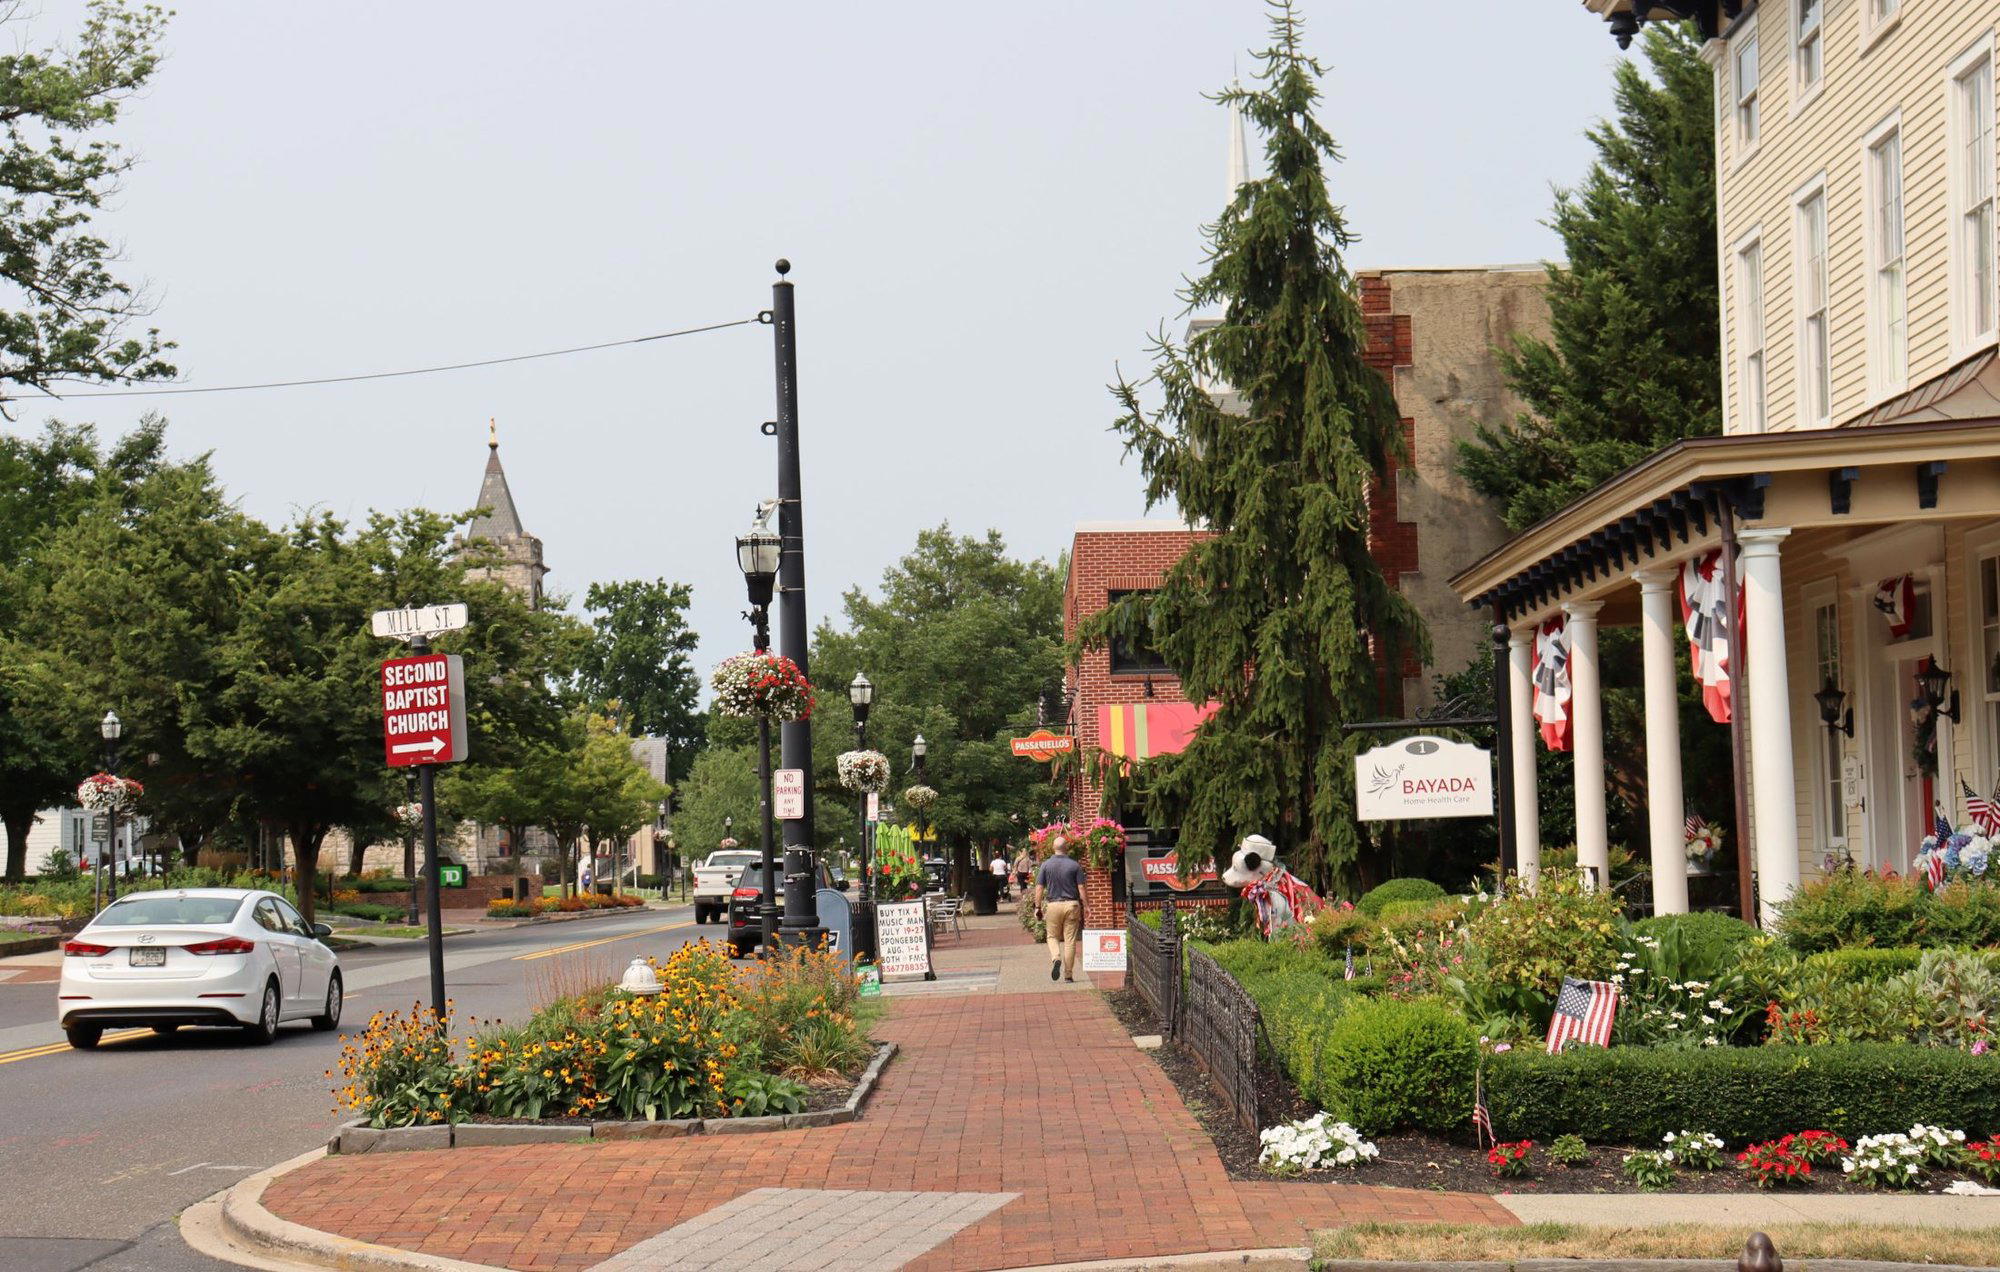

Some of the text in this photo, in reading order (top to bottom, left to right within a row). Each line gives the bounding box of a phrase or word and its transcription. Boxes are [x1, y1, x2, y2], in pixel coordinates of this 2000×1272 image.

[387, 607, 453, 633] MILL ST.
[385, 661, 446, 686] SECOND
[385, 685, 447, 711] BAPTIST
[387, 710, 449, 736] CHURCH
[1014, 737, 1070, 750] PASSARIELLO'S
[1418, 743, 1426, 754] 1
[783, 773, 794, 783] NO
[776, 786, 802, 795] PARKING
[1402, 778, 1475, 794] BAYADA
[1403, 795, 1470, 805] Home Health Care
[443, 869, 460, 882] TD
[879, 907, 918, 918] BUY TIX 4
[878, 917, 924, 927] MUSIC MAN
[881, 926, 924, 936] JULY 19-27
[880, 935, 924, 946] SPONGEBOB
[887, 945, 920, 954] AUG. 1-4
[881, 955, 900, 964] BOTH
[908, 954, 926, 962] FMC
